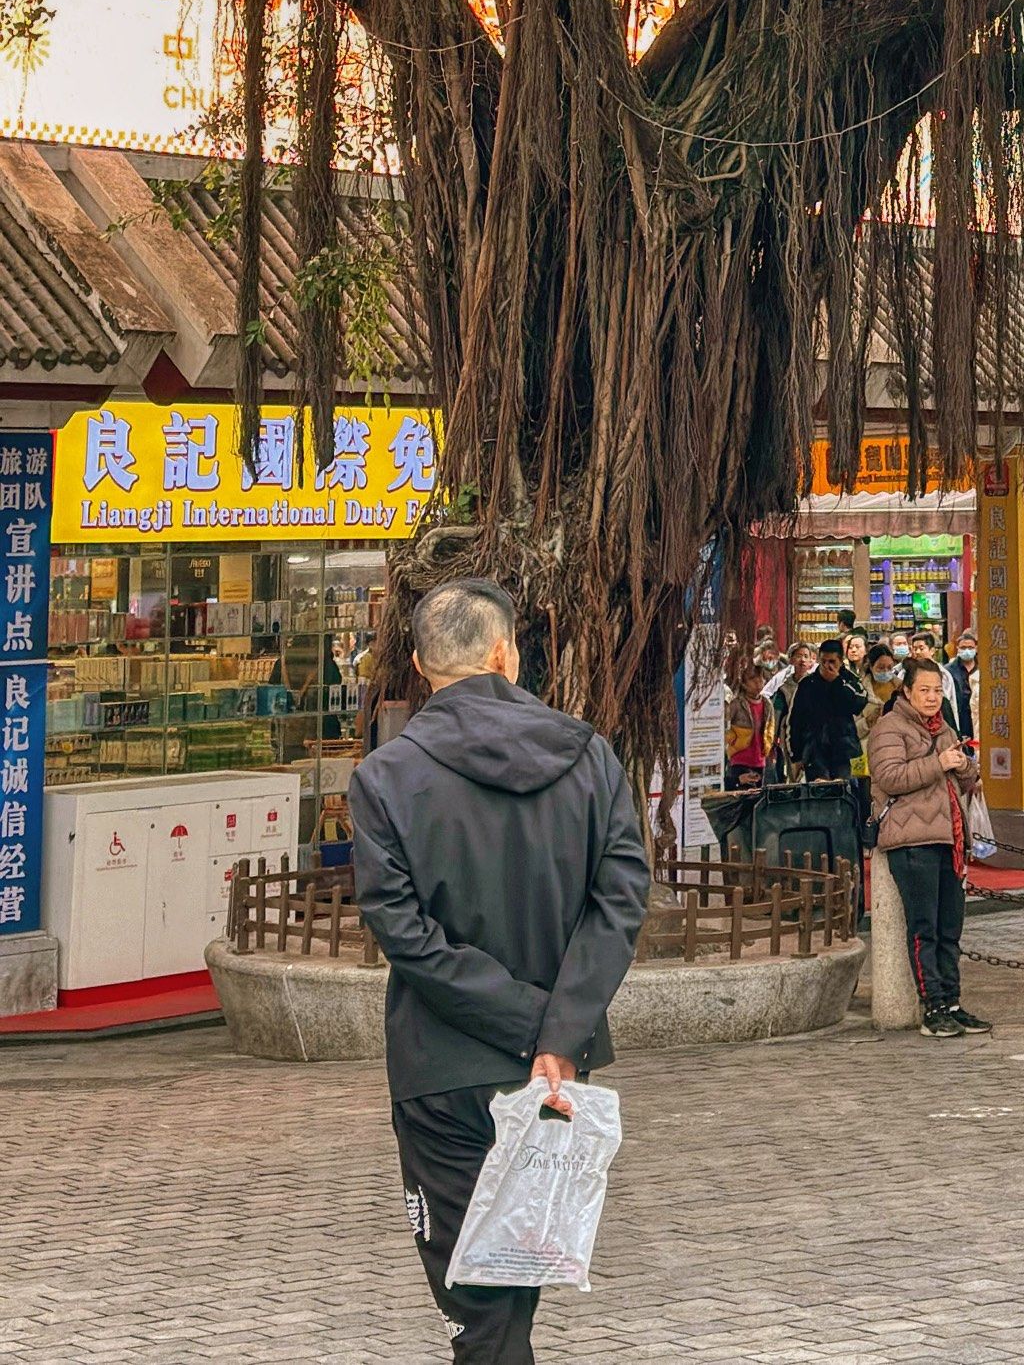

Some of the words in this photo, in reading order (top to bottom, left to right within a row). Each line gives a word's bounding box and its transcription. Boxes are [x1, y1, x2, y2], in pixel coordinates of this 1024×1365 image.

[0, 447, 47, 476] 旅游
[0, 482, 47, 511] 团队
[81, 500, 173, 532] Liangji
[182, 500, 336, 527] International
[345, 500, 398, 529] Duty
[3, 518, 38, 652] 宣讲点
[0, 674, 31, 924] 良记诚信经营
